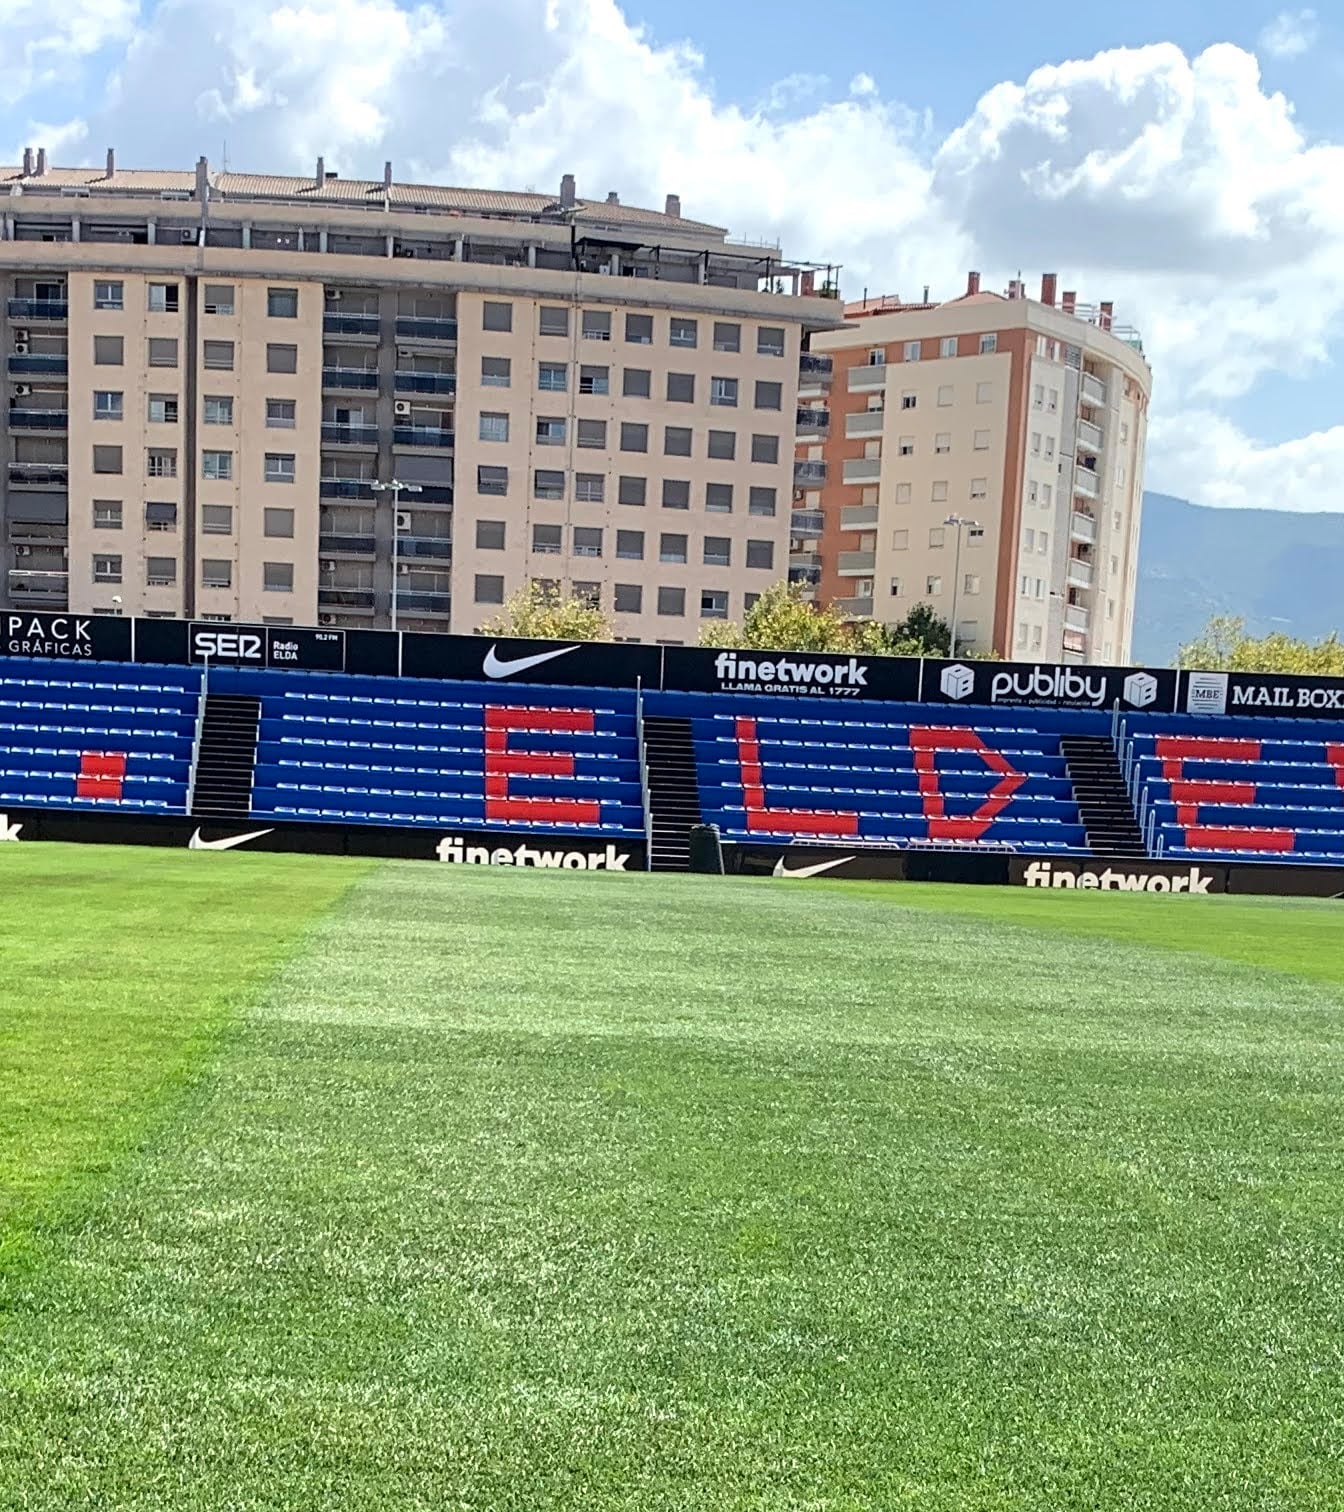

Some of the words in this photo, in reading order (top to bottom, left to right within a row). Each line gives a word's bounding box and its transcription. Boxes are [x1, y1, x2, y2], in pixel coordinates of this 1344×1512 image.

[9, 639, 92, 656] GRÁFICAS
[195, 632, 261, 659] SER
[273, 641, 298, 650] Radio
[273, 651, 298, 660] ELDA
[714, 652, 868, 685] finetwork
[721, 682, 762, 692] LLAMA
[764, 684, 808, 694] GRATIS
[809, 686, 825, 695] AL
[829, 687, 860, 696] 1777
[991, 665, 1107, 707] publiby
[1195, 689, 1220, 699] MBE
[1231, 685, 1294, 707] MAIL
[436, 837, 630, 871] finetwork
[1024, 862, 1213, 894] finetwork
